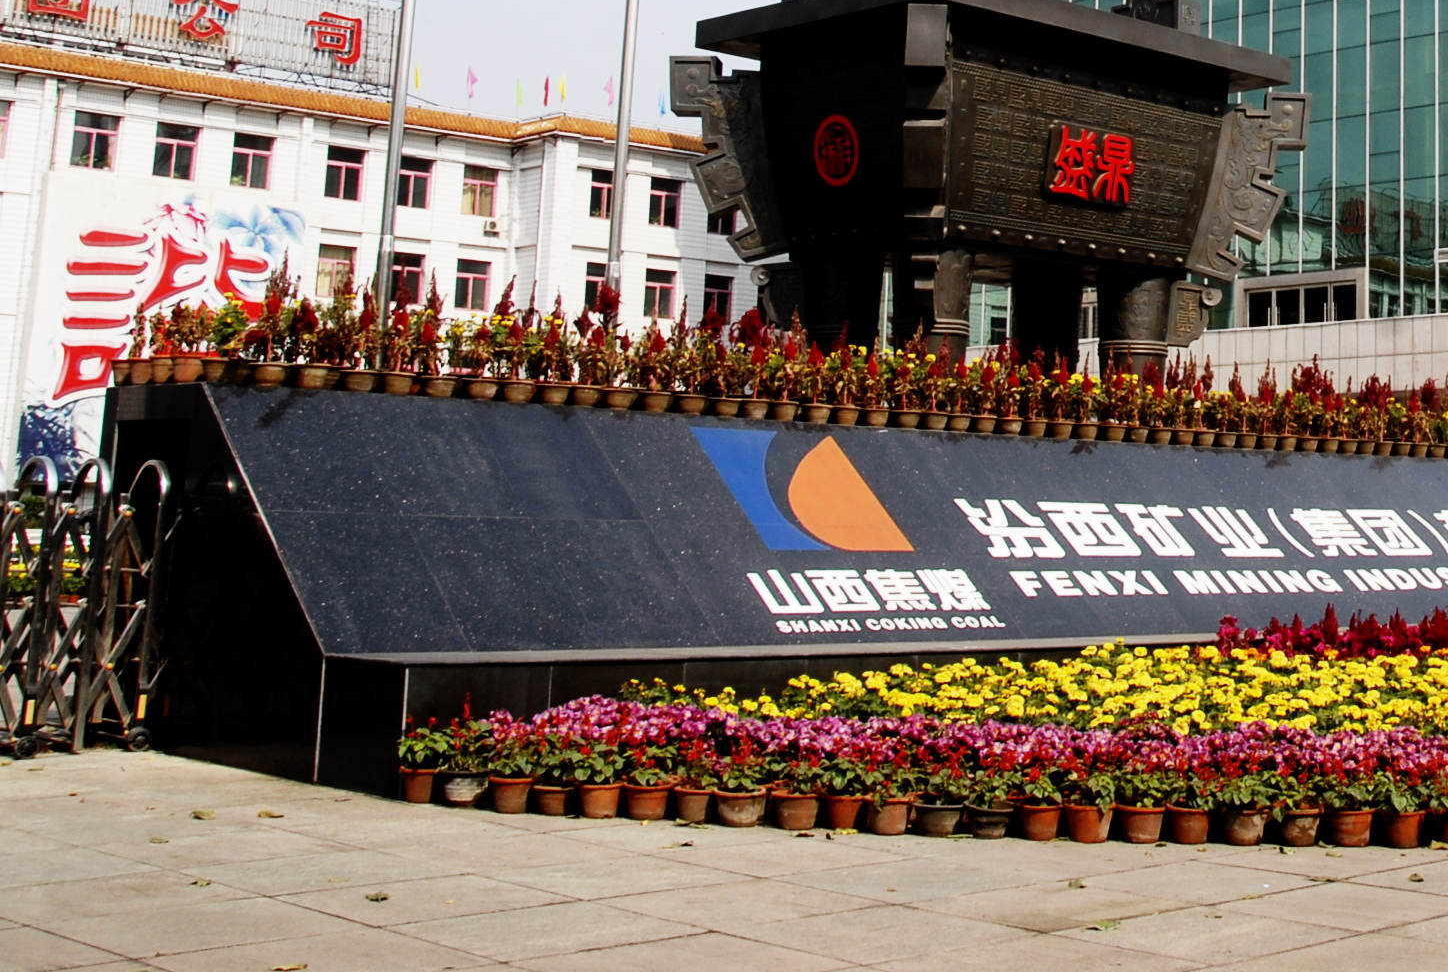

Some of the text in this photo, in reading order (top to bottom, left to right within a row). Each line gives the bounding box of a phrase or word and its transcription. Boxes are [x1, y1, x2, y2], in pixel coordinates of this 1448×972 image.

[746, 569, 992, 615] 山西焦煤
[1009, 569, 1169, 598] FENXI
[1173, 568, 1344, 595] MINING
[775, 613, 1007, 635] SHANXI COKING COAL
